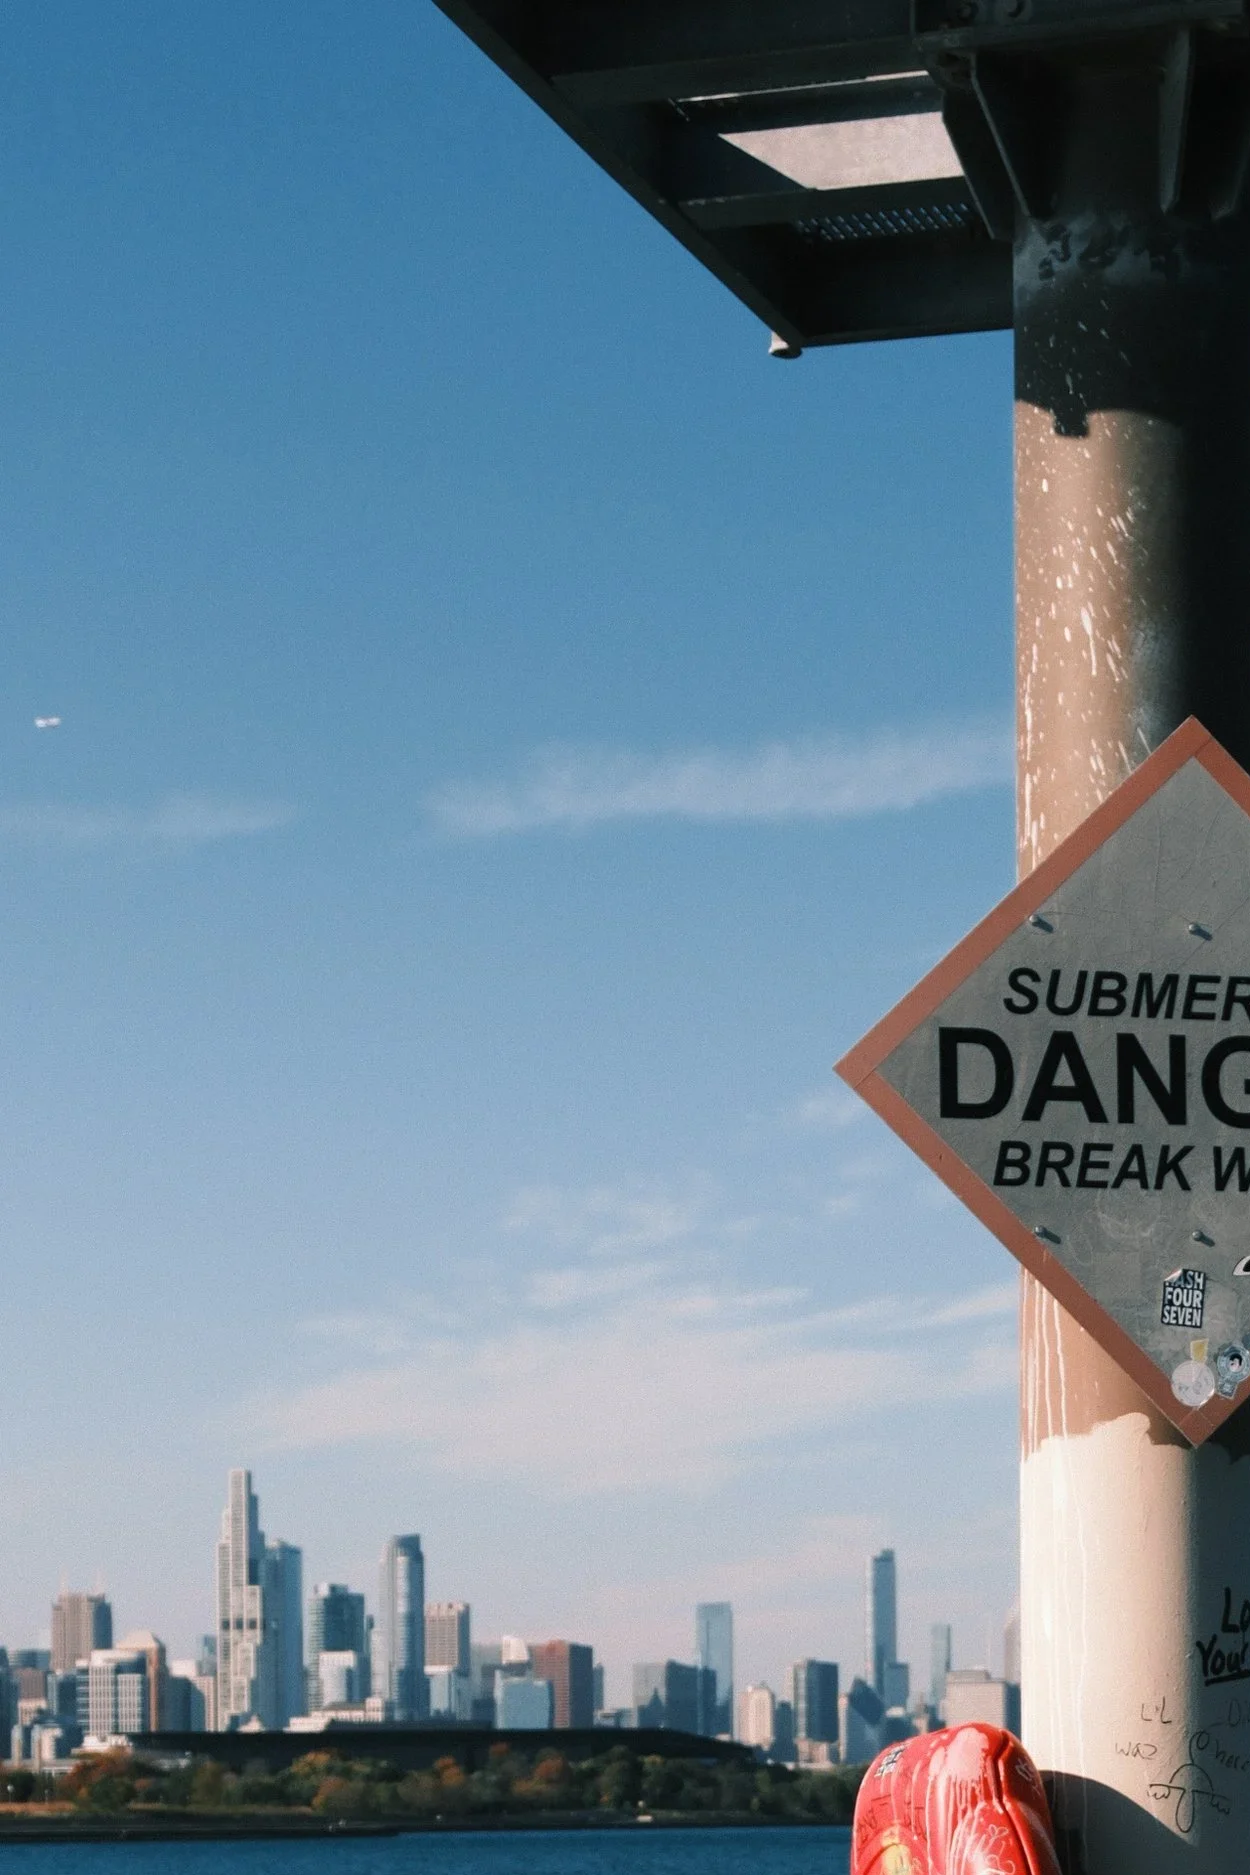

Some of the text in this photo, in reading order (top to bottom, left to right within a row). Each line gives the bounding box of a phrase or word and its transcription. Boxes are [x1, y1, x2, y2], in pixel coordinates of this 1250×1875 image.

[993, 1140, 1196, 1191] BREAK
[1165, 1270, 1205, 1290] ASH
[1165, 1287, 1203, 1309] FOUR
[1162, 1304, 1202, 1327] SEVEN
